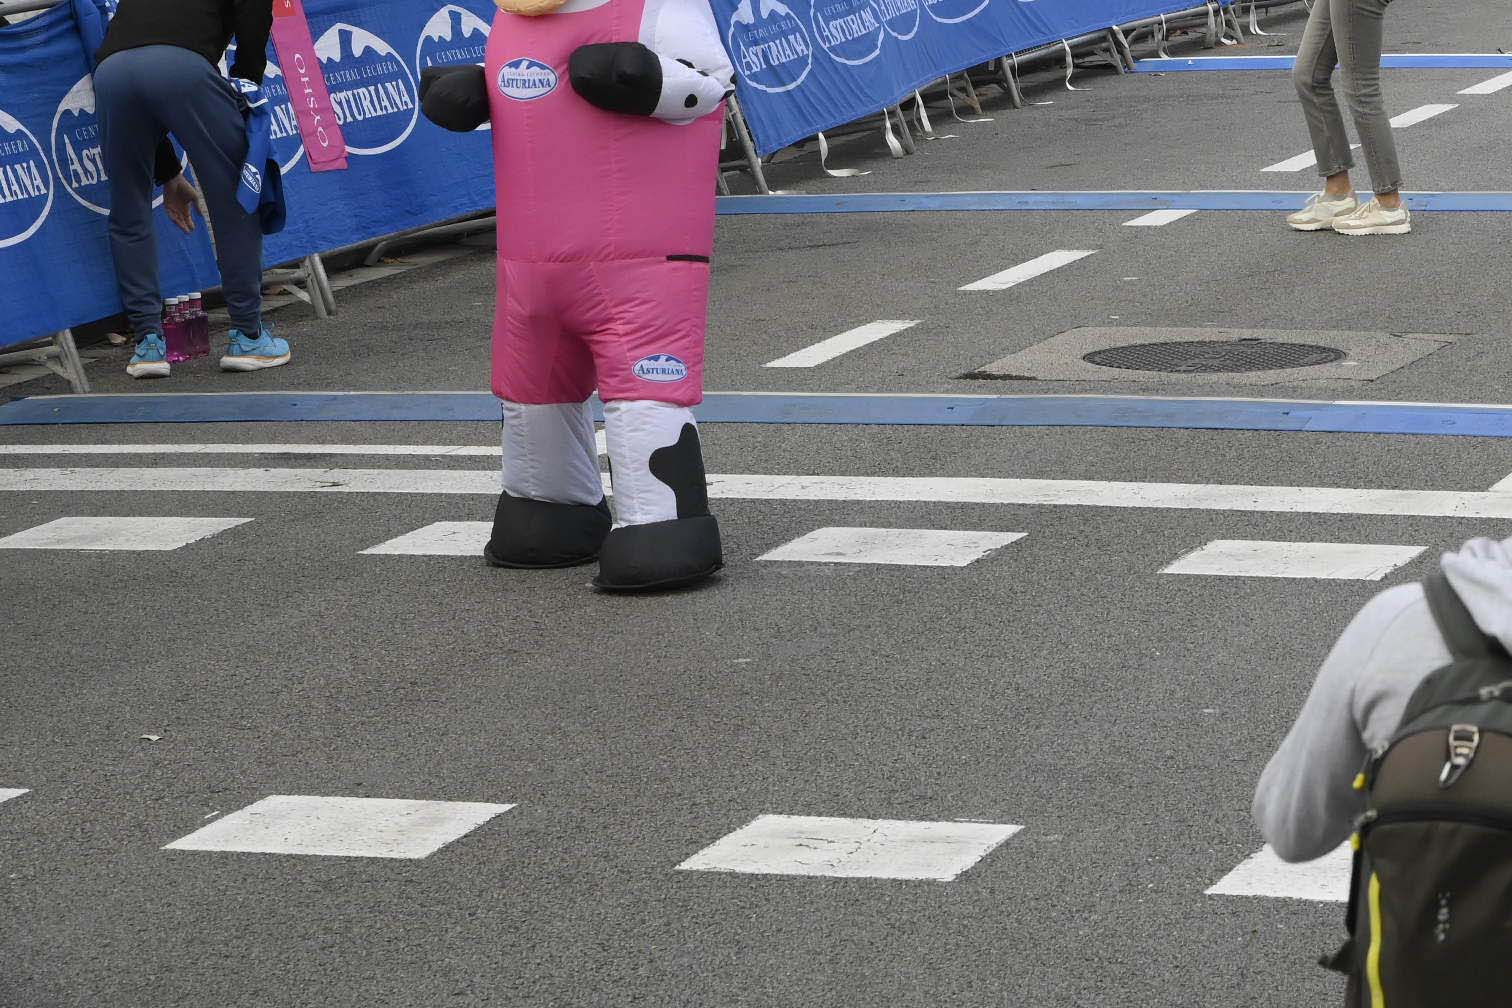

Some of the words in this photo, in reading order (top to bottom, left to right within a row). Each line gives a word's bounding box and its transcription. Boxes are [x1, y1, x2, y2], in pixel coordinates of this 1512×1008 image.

[324, 66, 360, 86] CENTRAL
[360, 60, 398, 81] LECHERA
[500, 72, 552, 89] ASTURIANA
[294, 52, 330, 148] OYSHO
[331, 78, 414, 126] STURIANA
[637, 363, 684, 377] ASTURIANA
